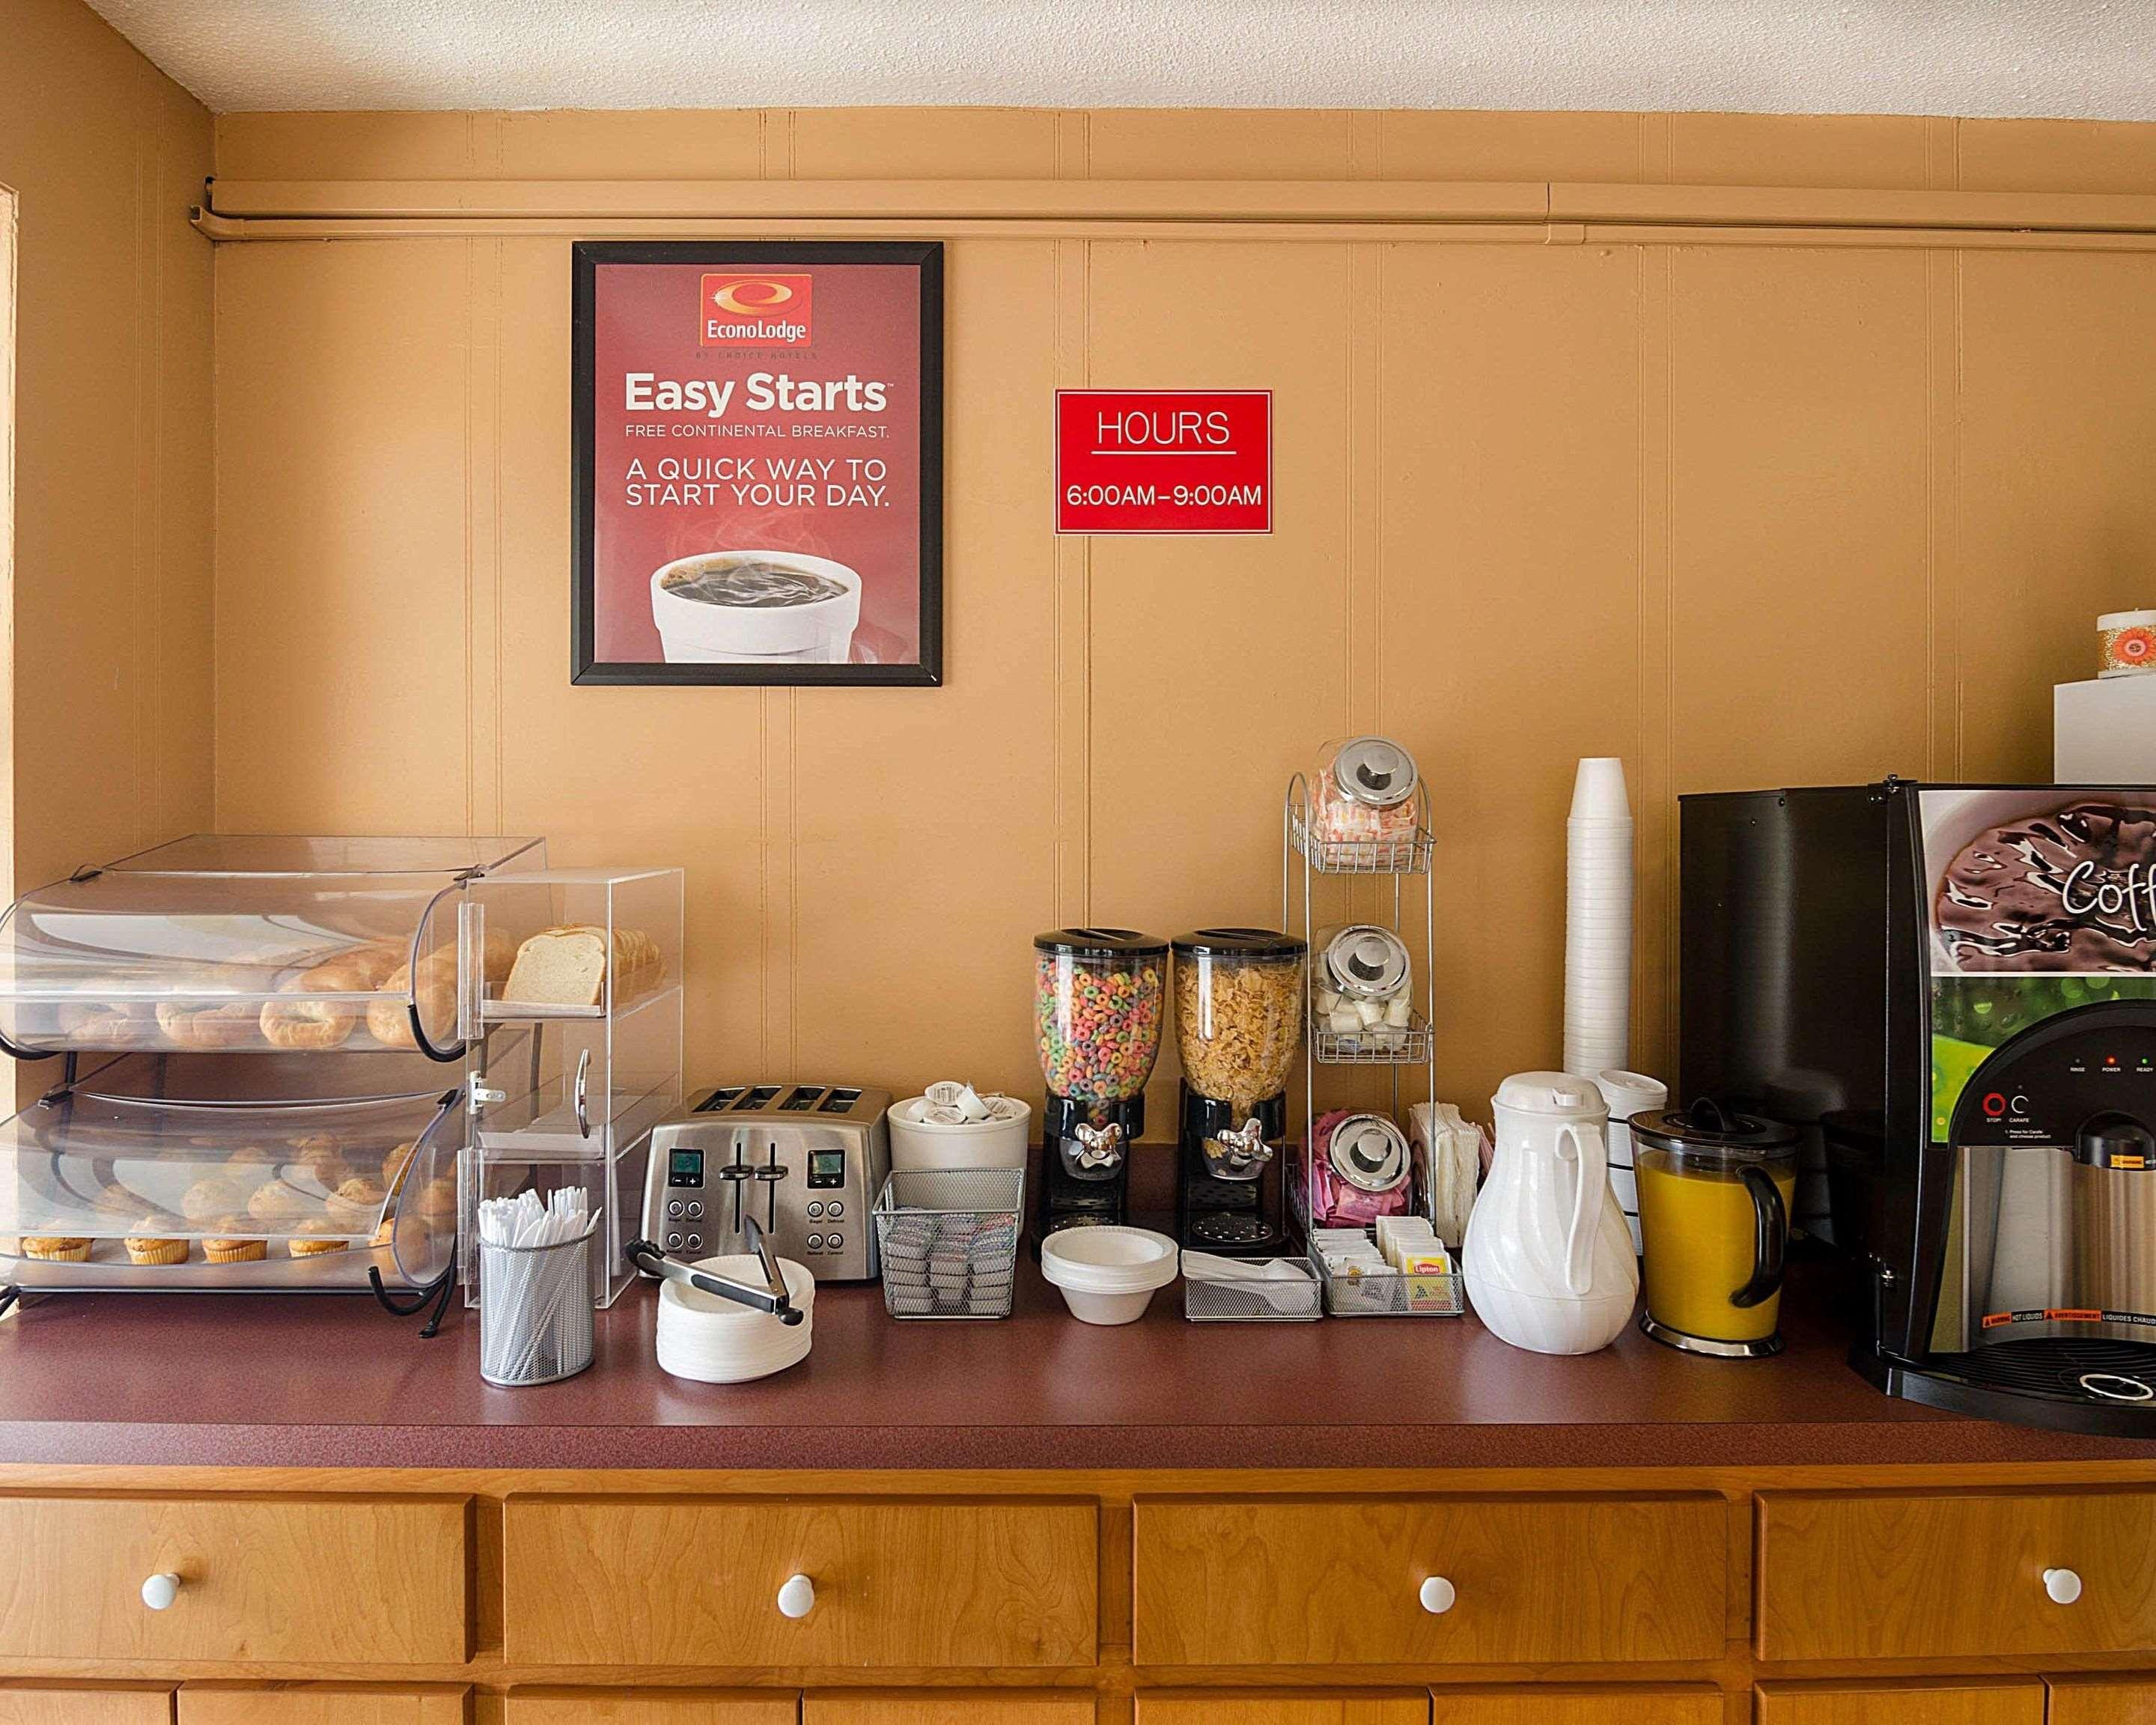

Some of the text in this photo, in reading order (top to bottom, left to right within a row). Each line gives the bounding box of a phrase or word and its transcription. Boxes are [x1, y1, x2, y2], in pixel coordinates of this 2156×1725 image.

[707, 320, 806, 343] EconoLodge
[626, 373, 735, 418] Easy
[626, 425, 889, 438] FREE CONTINENTAL BREAKFAST.
[1098, 411, 1230, 445] HOURS
[626, 458, 886, 481] A QUICK WAY TO
[626, 484, 889, 507] START YOUR DAY.
[1415, 1266, 1438, 1274] Lipton
